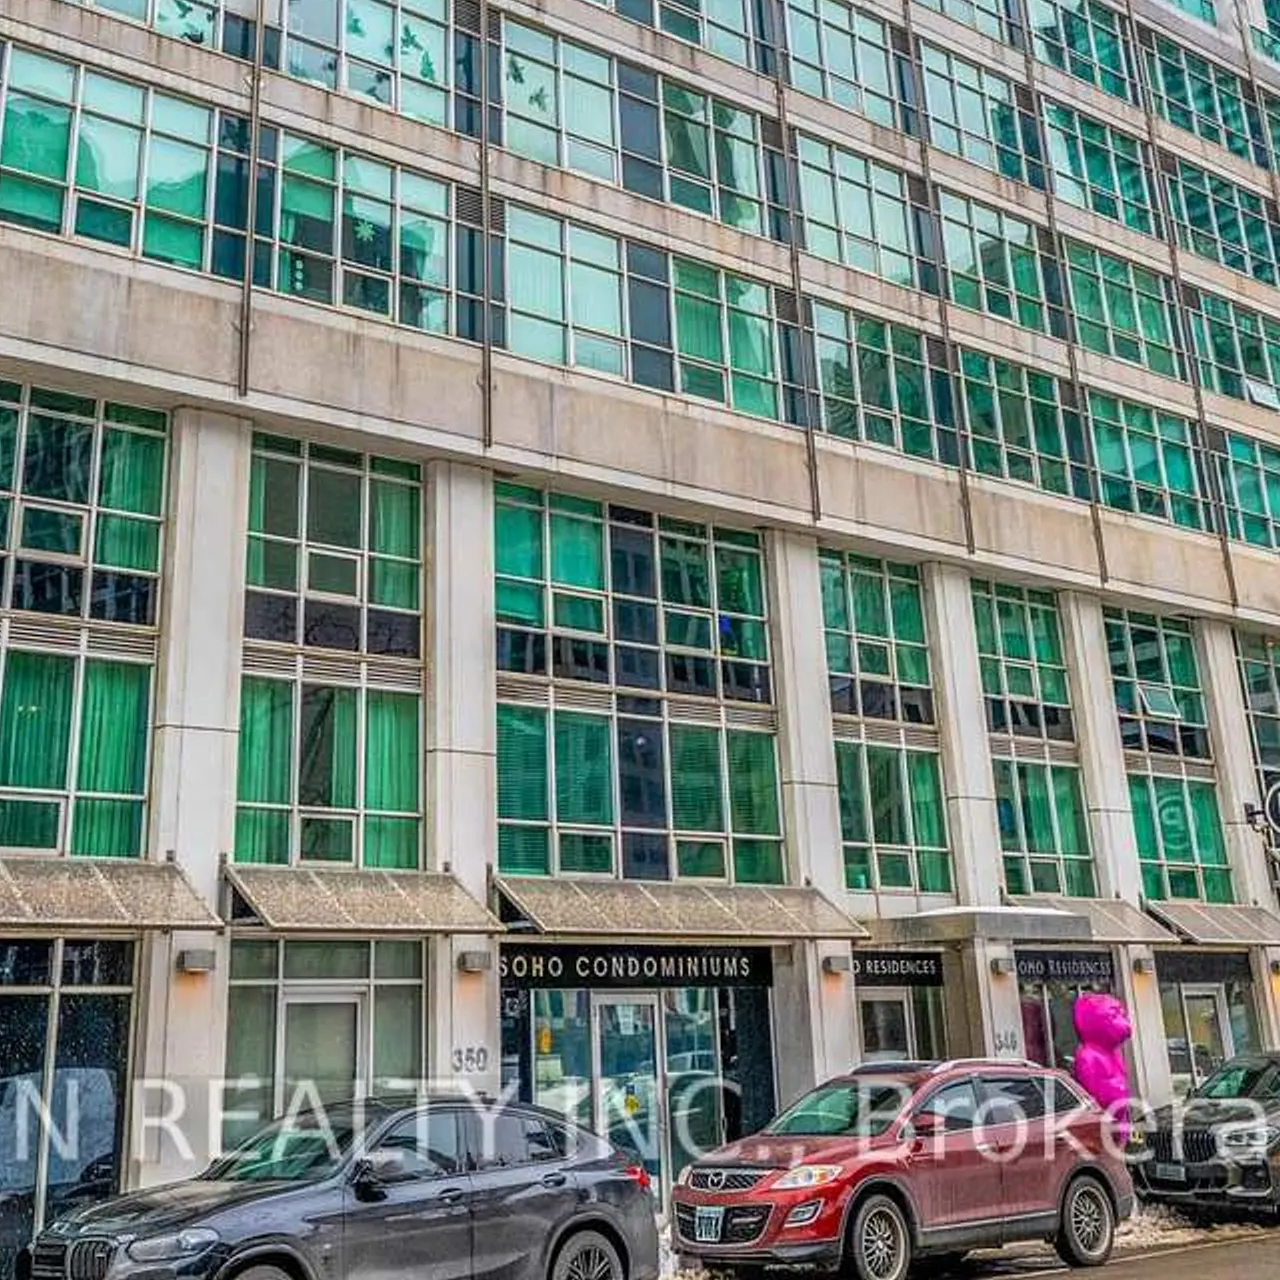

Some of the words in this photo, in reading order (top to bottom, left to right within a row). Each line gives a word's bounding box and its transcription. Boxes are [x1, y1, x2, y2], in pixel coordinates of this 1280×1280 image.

[500, 956, 563, 977] SOHO
[575, 956, 751, 977] CONDOMINIUMS
[865, 959, 937, 975] RESIDENCES
[451, 1047, 489, 1073] 350
